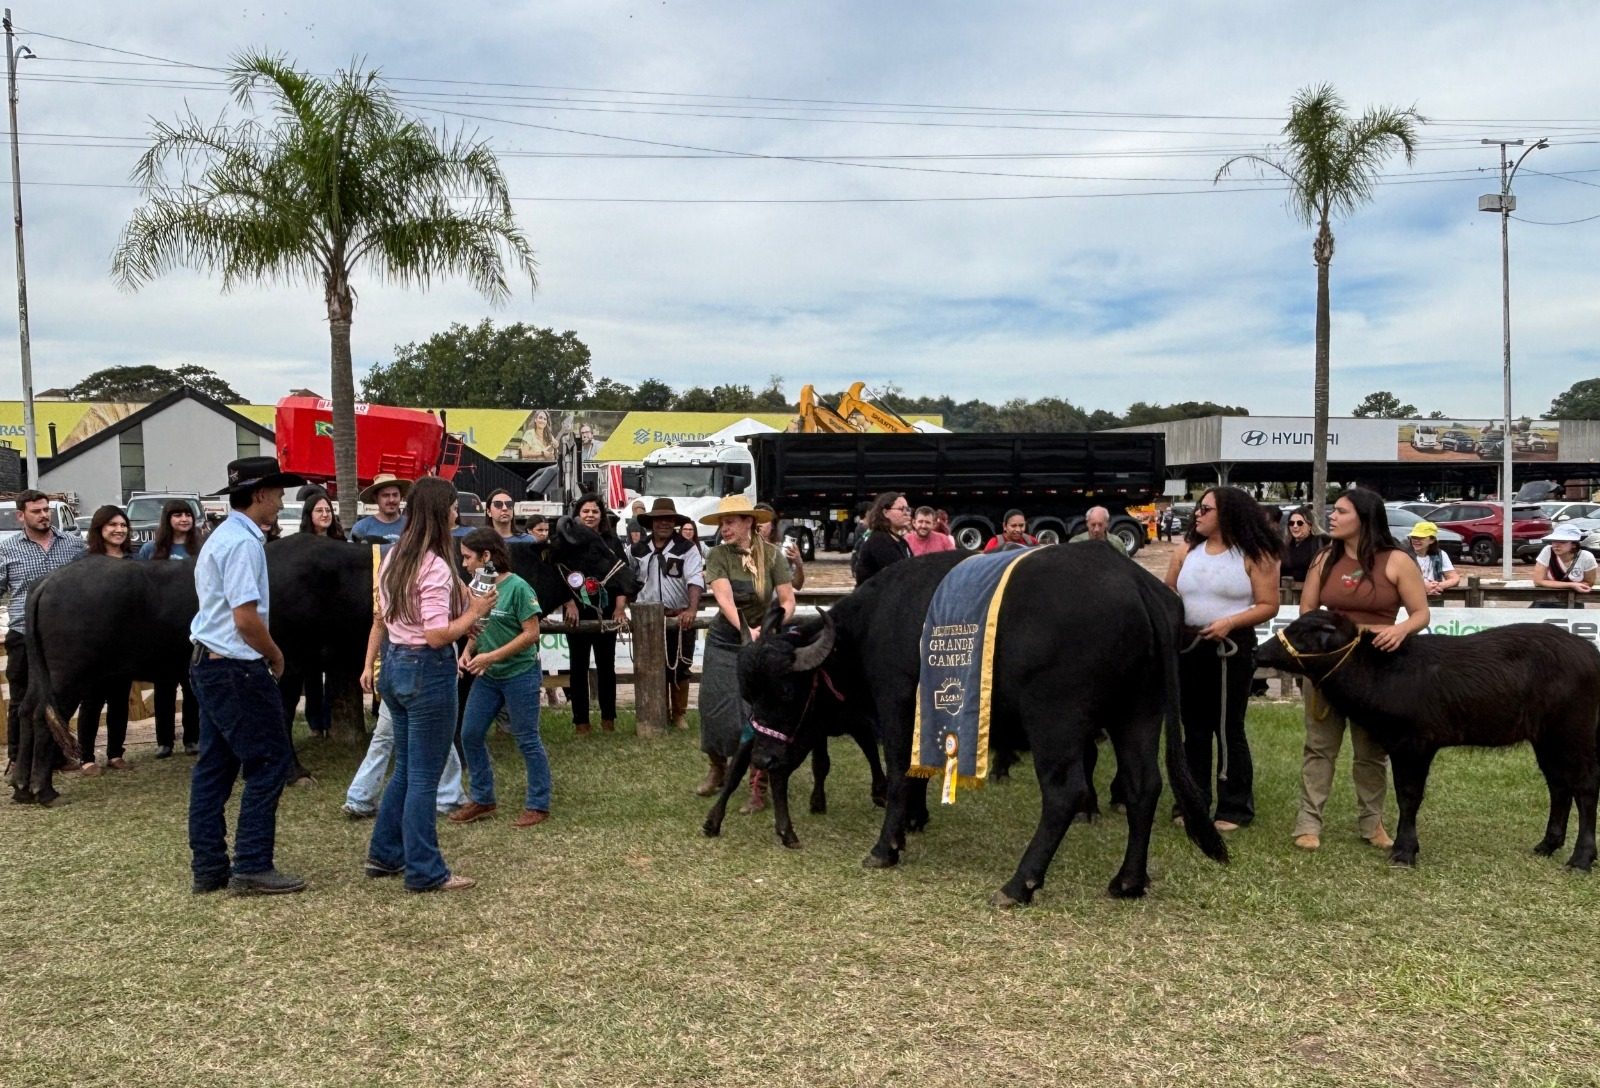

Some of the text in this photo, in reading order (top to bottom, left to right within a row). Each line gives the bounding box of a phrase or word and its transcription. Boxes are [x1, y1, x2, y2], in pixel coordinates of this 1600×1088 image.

[1272, 432, 1339, 445] HYUNAI
[929, 638, 975, 651] GRANDE
[928, 650, 973, 667] CAMPEÃ
